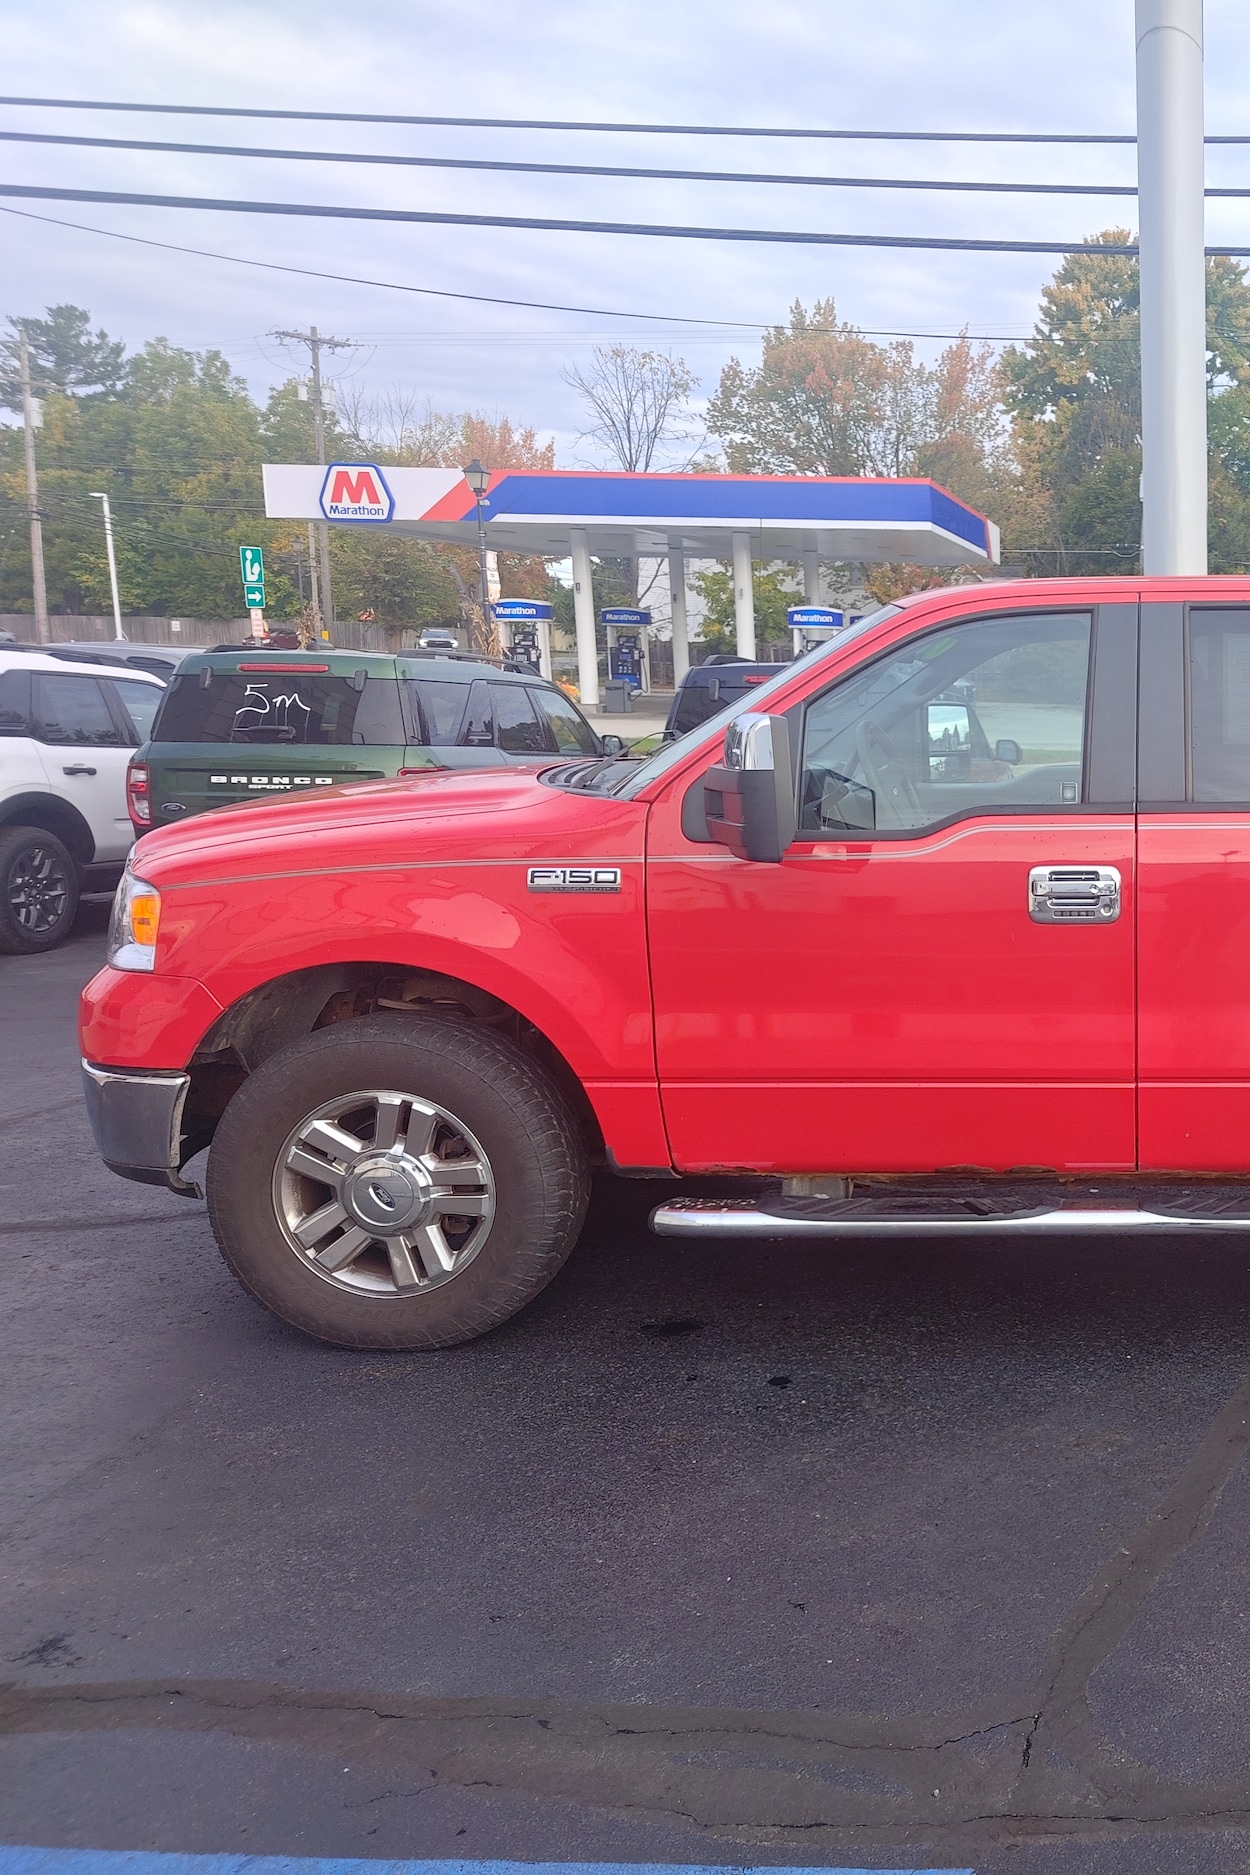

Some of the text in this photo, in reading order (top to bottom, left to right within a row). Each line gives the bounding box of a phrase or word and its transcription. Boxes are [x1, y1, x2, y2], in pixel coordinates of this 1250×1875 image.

[330, 470, 381, 504] M
[329, 505, 384, 516] Marathon
[496, 606, 536, 615] Marathon
[605, 613, 640, 621] Marathon
[793, 613, 833, 622] Marathon
[210, 775, 333, 785] BRONCO
[291, 1280, 454, 1323] COUNTRY
